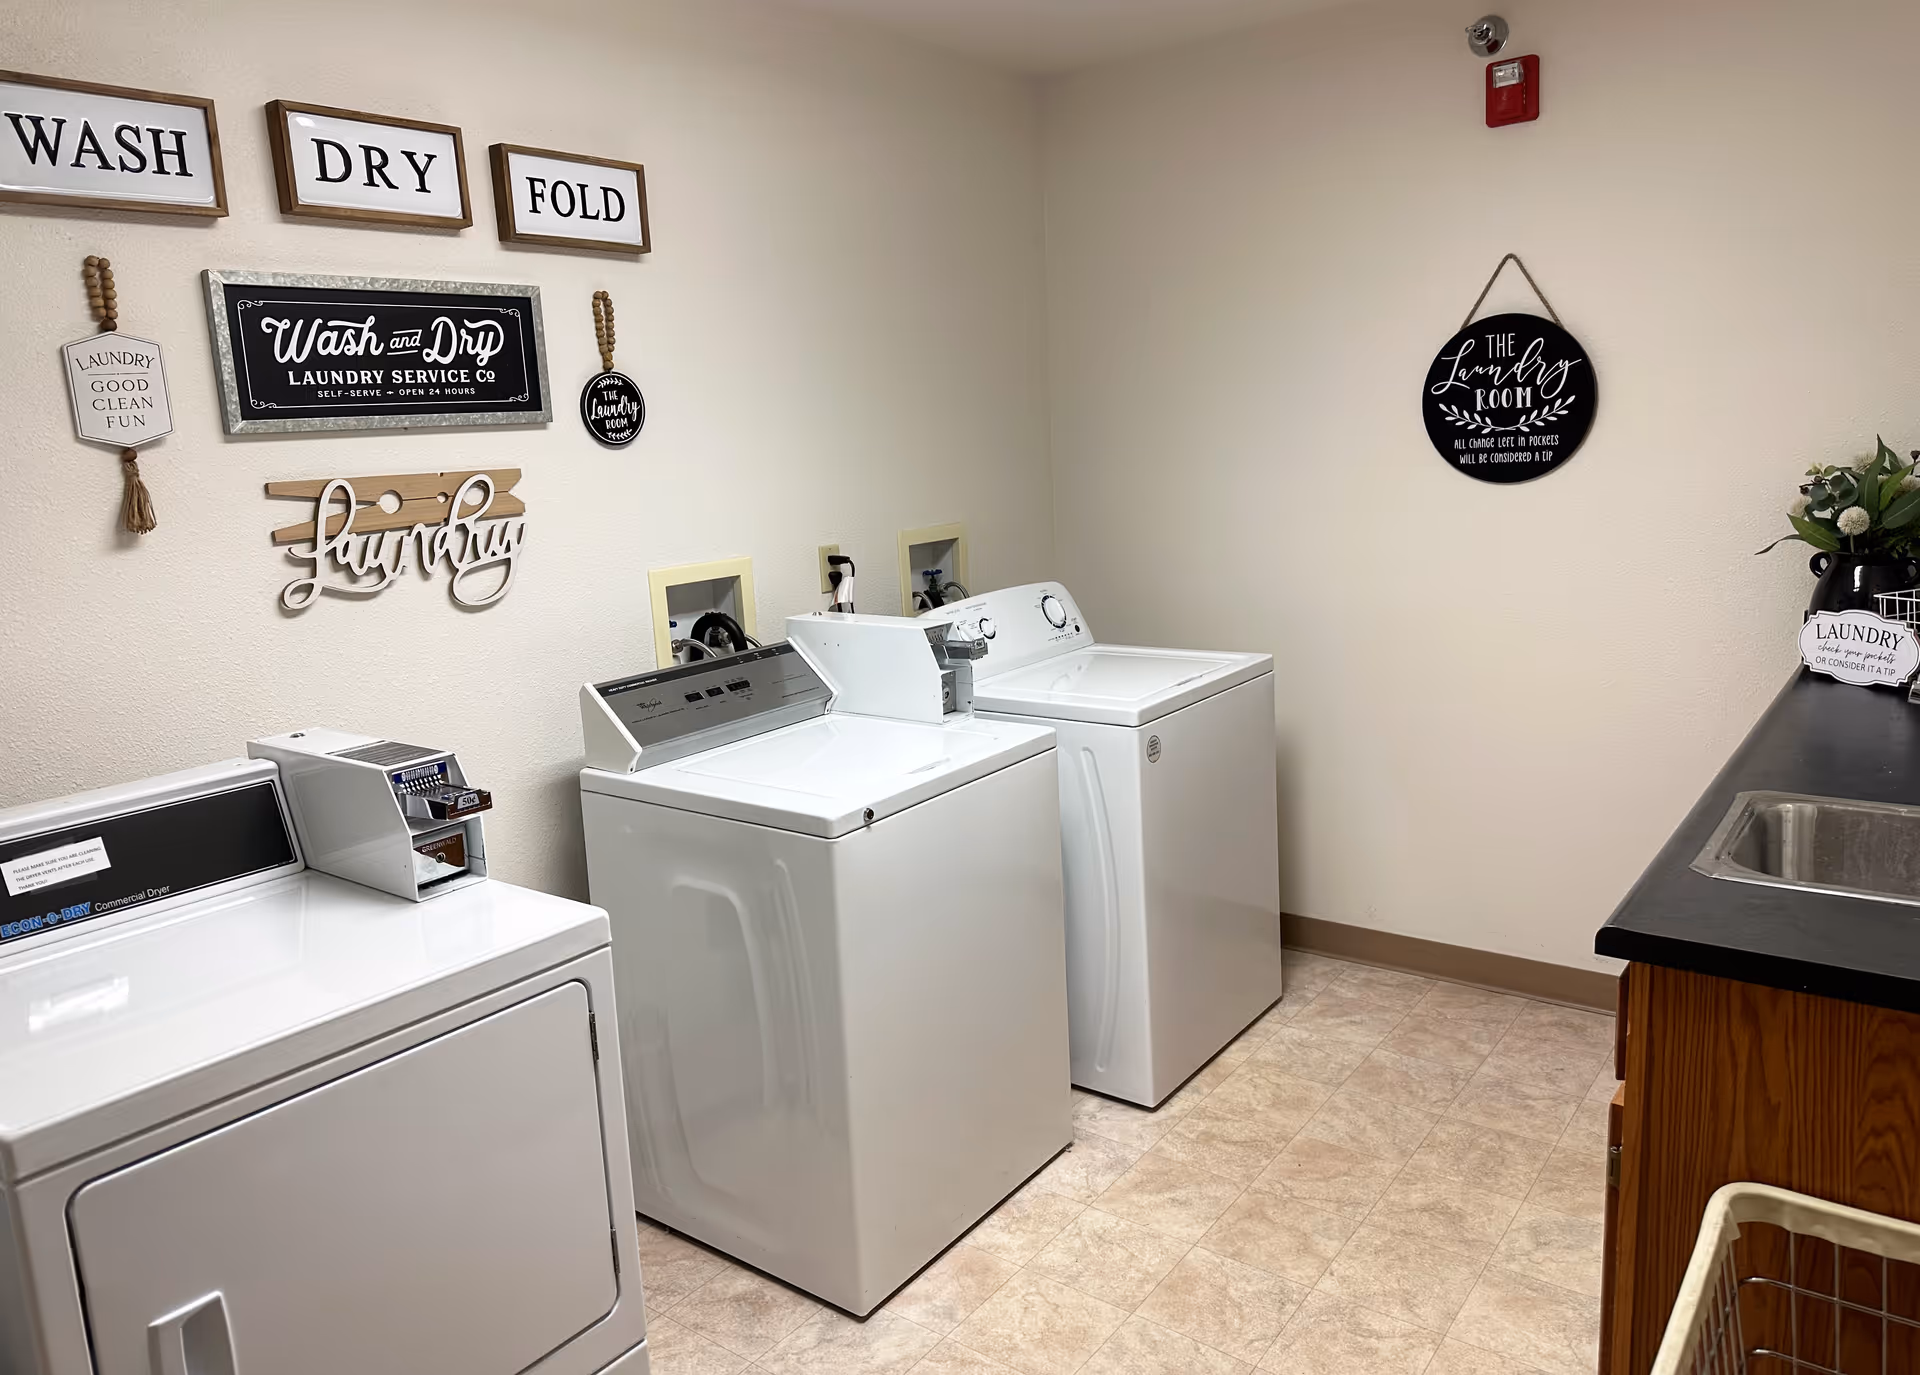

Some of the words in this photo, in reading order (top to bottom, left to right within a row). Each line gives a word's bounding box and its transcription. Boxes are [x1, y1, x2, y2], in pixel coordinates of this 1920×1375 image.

[3, 112, 194, 177] WASH
[311, 138, 437, 193] DRY
[525, 176, 625, 222] FOLD
[261, 315, 385, 364] Wash
[388, 331, 422, 351] and
[423, 316, 504, 366] Dry
[1485, 333, 1516, 359] THE
[75, 351, 155, 371] LAUNDRY
[1431, 337, 1582, 399] Laundry
[91, 379, 149, 392] GOOD
[288, 370, 384, 386] LAUNDRY
[391, 369, 471, 384] SERVICE
[317, 389, 382, 398] SELF-SERVE
[399, 388, 425, 396] OPEN
[444, 387, 476, 395] HOURS
[602, 390, 618, 401] THE
[1474, 386, 1532, 411] ROOM
[92, 396, 154, 411] CLEAN
[591, 395, 640, 422] Laundry
[106, 415, 145, 428] FUN
[605, 417, 628, 429] ROOM
[1454, 439, 1466, 449] ALL
[1534, 451, 1540, 462] A
[1816, 623, 1904, 651] LAUNDRY
[1817, 640, 1841, 654] check
[1844, 648, 1862, 659] your
[1863, 650, 1896, 664] pockets
[1815, 655, 1826, 664] OR
[1828, 658, 1865, 672] CONSIDER
[1867, 665, 1875, 673] IT
[1876, 667, 1882, 675] A
[1884, 668, 1896, 676] TIP
[462, 795, 476, 806] 50¢
[421, 837, 457, 853] GREENWALD
[13, 866, 30, 874] PLEASE
[30, 862, 45, 870] MAKE
[78, 847, 102, 857] CLEANING
[26, 872, 42, 880] DRYER
[42, 868, 57, 876] VENTS
[57, 863, 72, 871] AFTER
[18, 883, 35, 891] THANK
[1, 901, 91, 938] ECON-O-DRY
[94, 890, 146, 912] Commercial
[147, 885, 170, 898] Dryer
